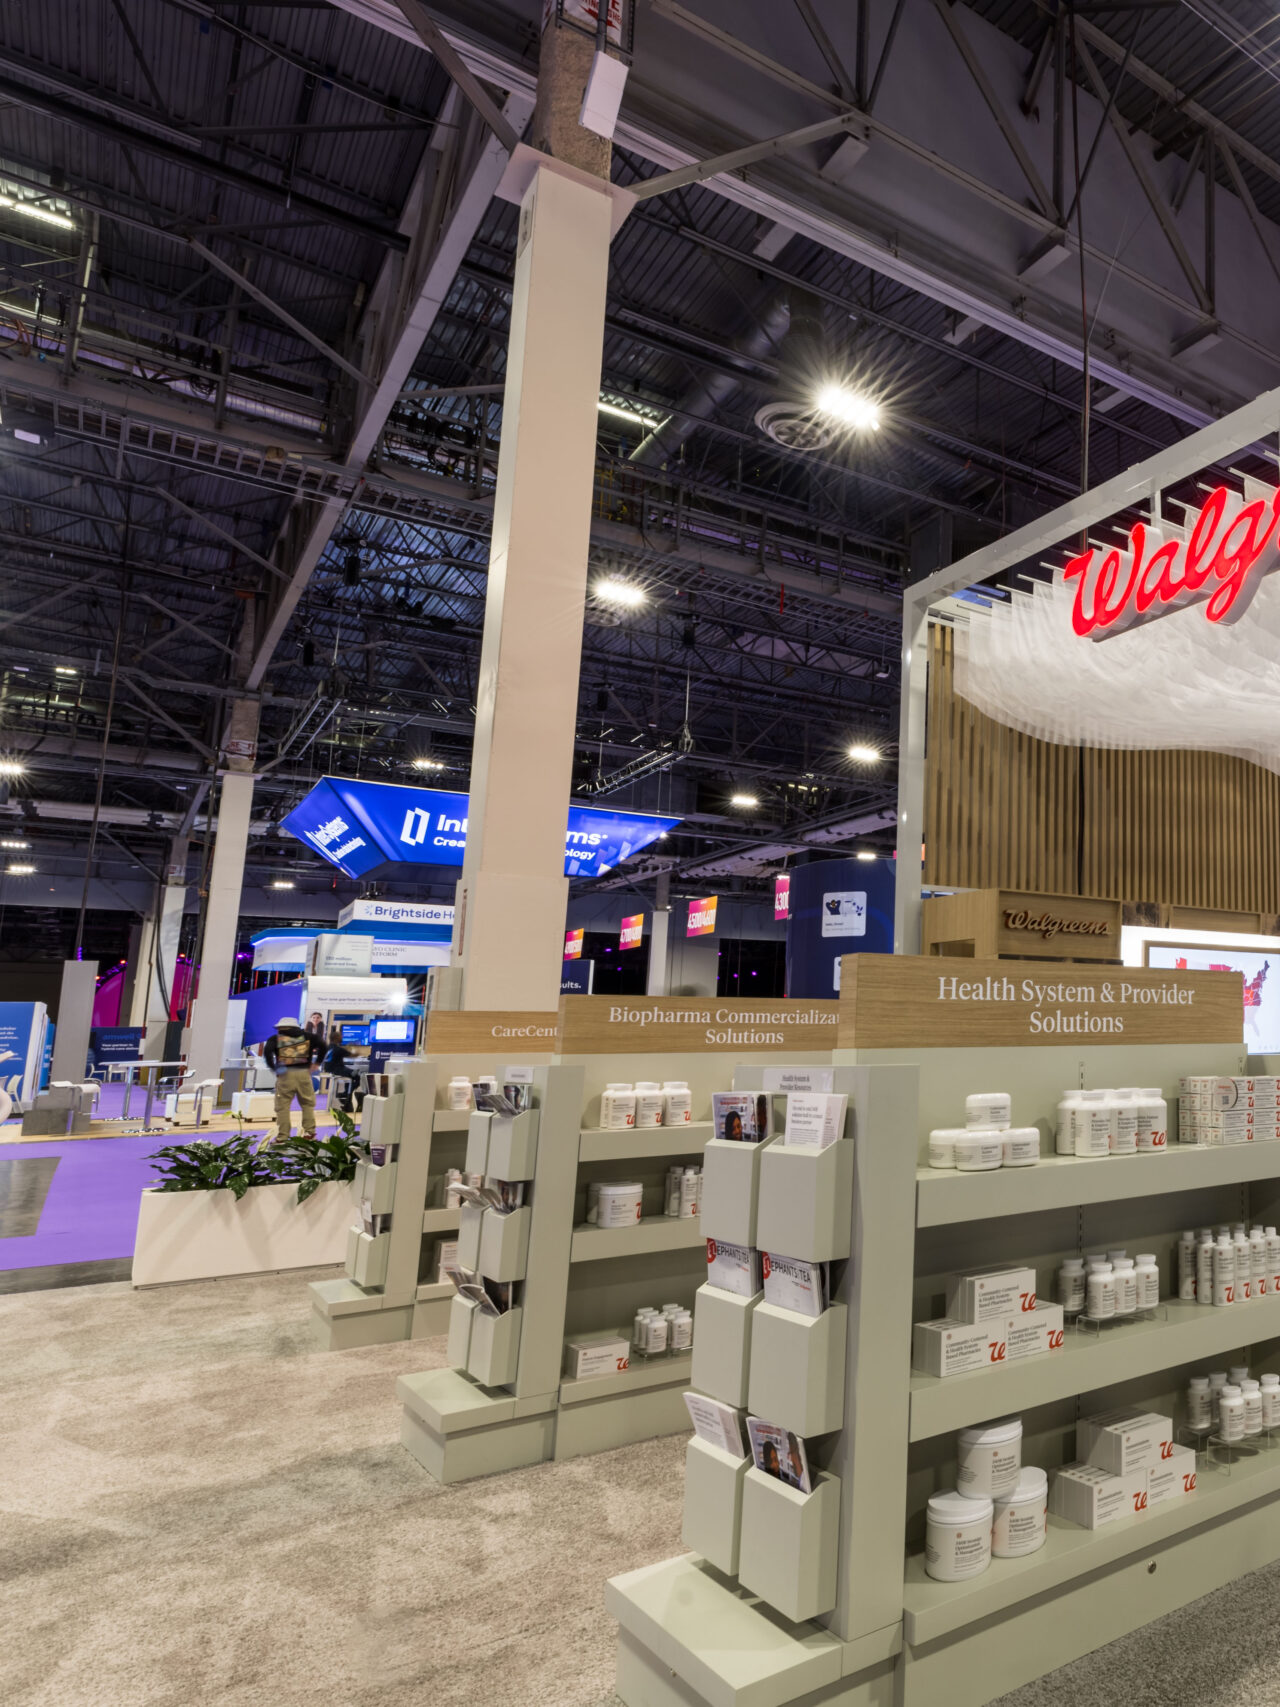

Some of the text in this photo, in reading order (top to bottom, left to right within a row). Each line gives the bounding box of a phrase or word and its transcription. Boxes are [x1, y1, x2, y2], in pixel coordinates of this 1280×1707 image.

[433, 837, 467, 848] Crea
[564, 849, 596, 860] ology
[374, 906, 441, 919] Brightside
[1003, 908, 1112, 939] Walgreens
[560, 981, 581, 989] ults.
[937, 976, 1196, 1007] Health System & Provider
[608, 1006, 711, 1026] Biopharma
[1029, 1010, 1124, 1033] Solutions
[491, 1025, 558, 1038] CareCent
[705, 1028, 785, 1044] Solutions
